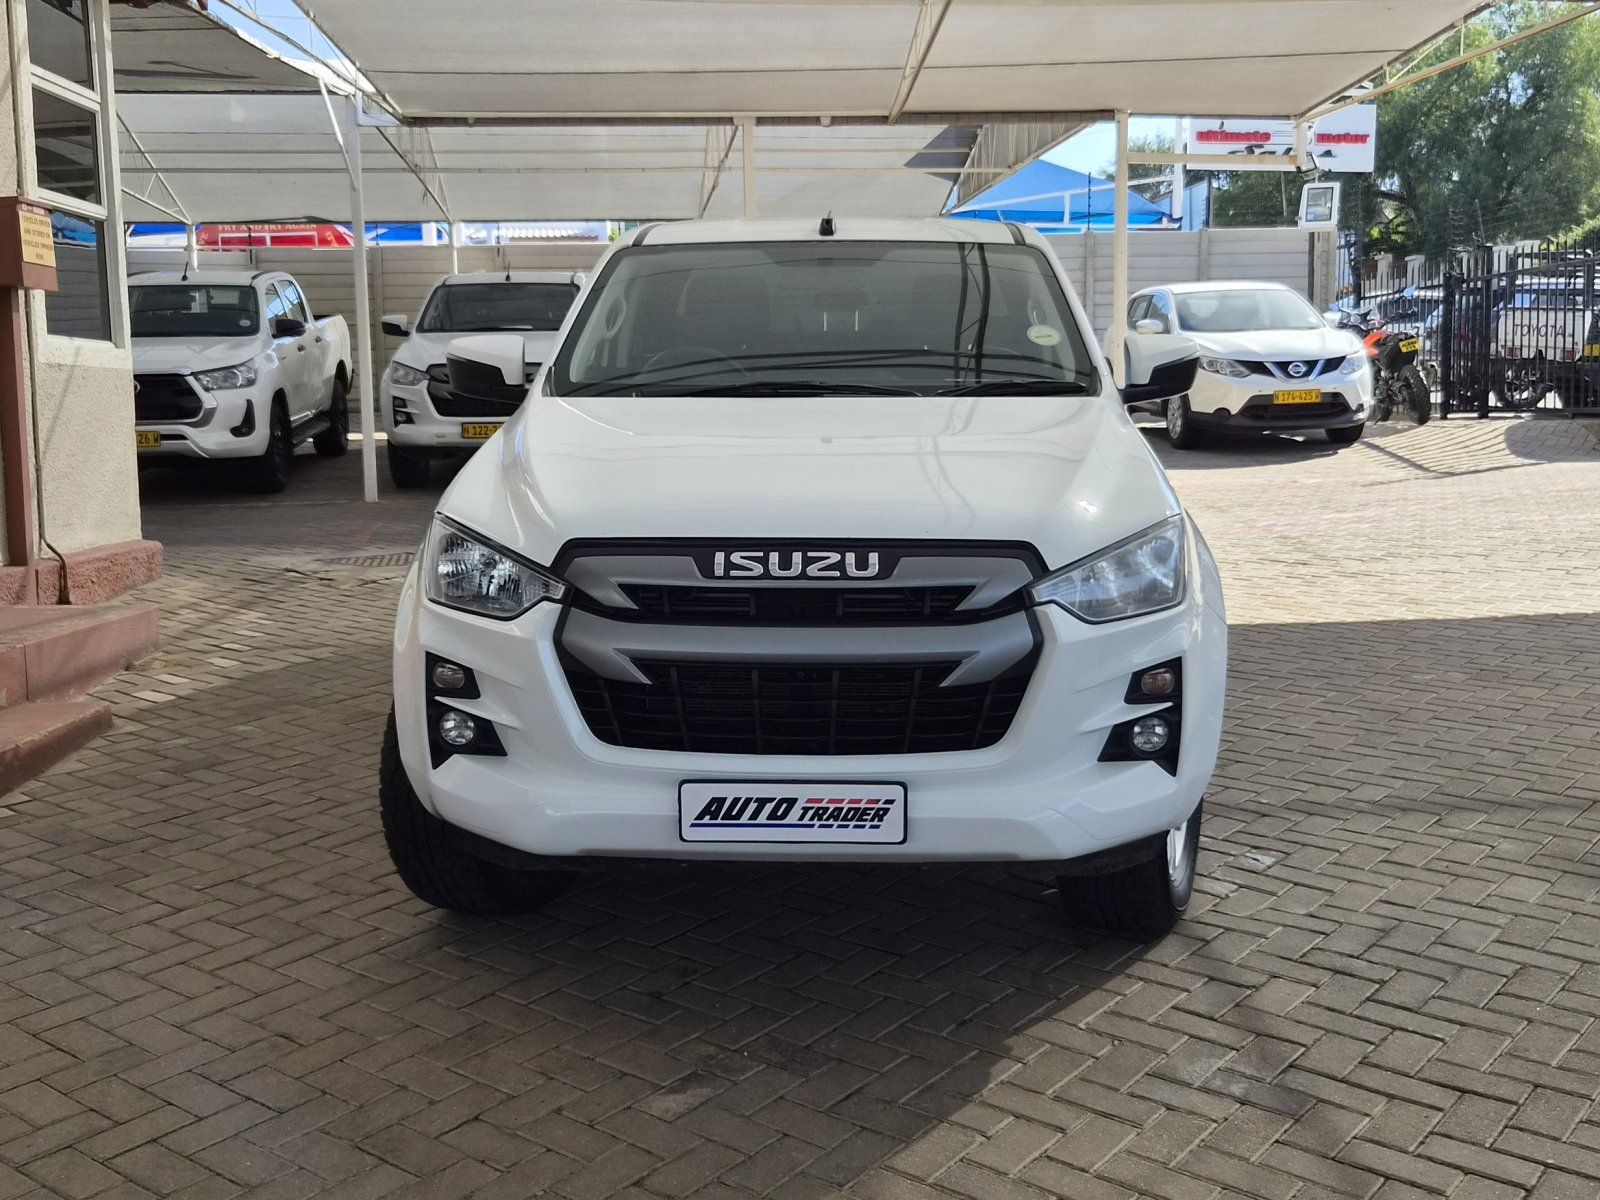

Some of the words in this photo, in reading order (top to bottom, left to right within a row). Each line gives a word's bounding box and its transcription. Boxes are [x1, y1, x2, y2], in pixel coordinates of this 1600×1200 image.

[1196, 127, 1271, 142] ultimate
[1316, 132, 1370, 143] motor
[1514, 324, 1564, 338] TOYOTA
[1281, 391, 1312, 402] 174-425
[714, 551, 879, 577] ISUZU
[694, 797, 799, 821] AUTO
[798, 806, 891, 823] TRADER
